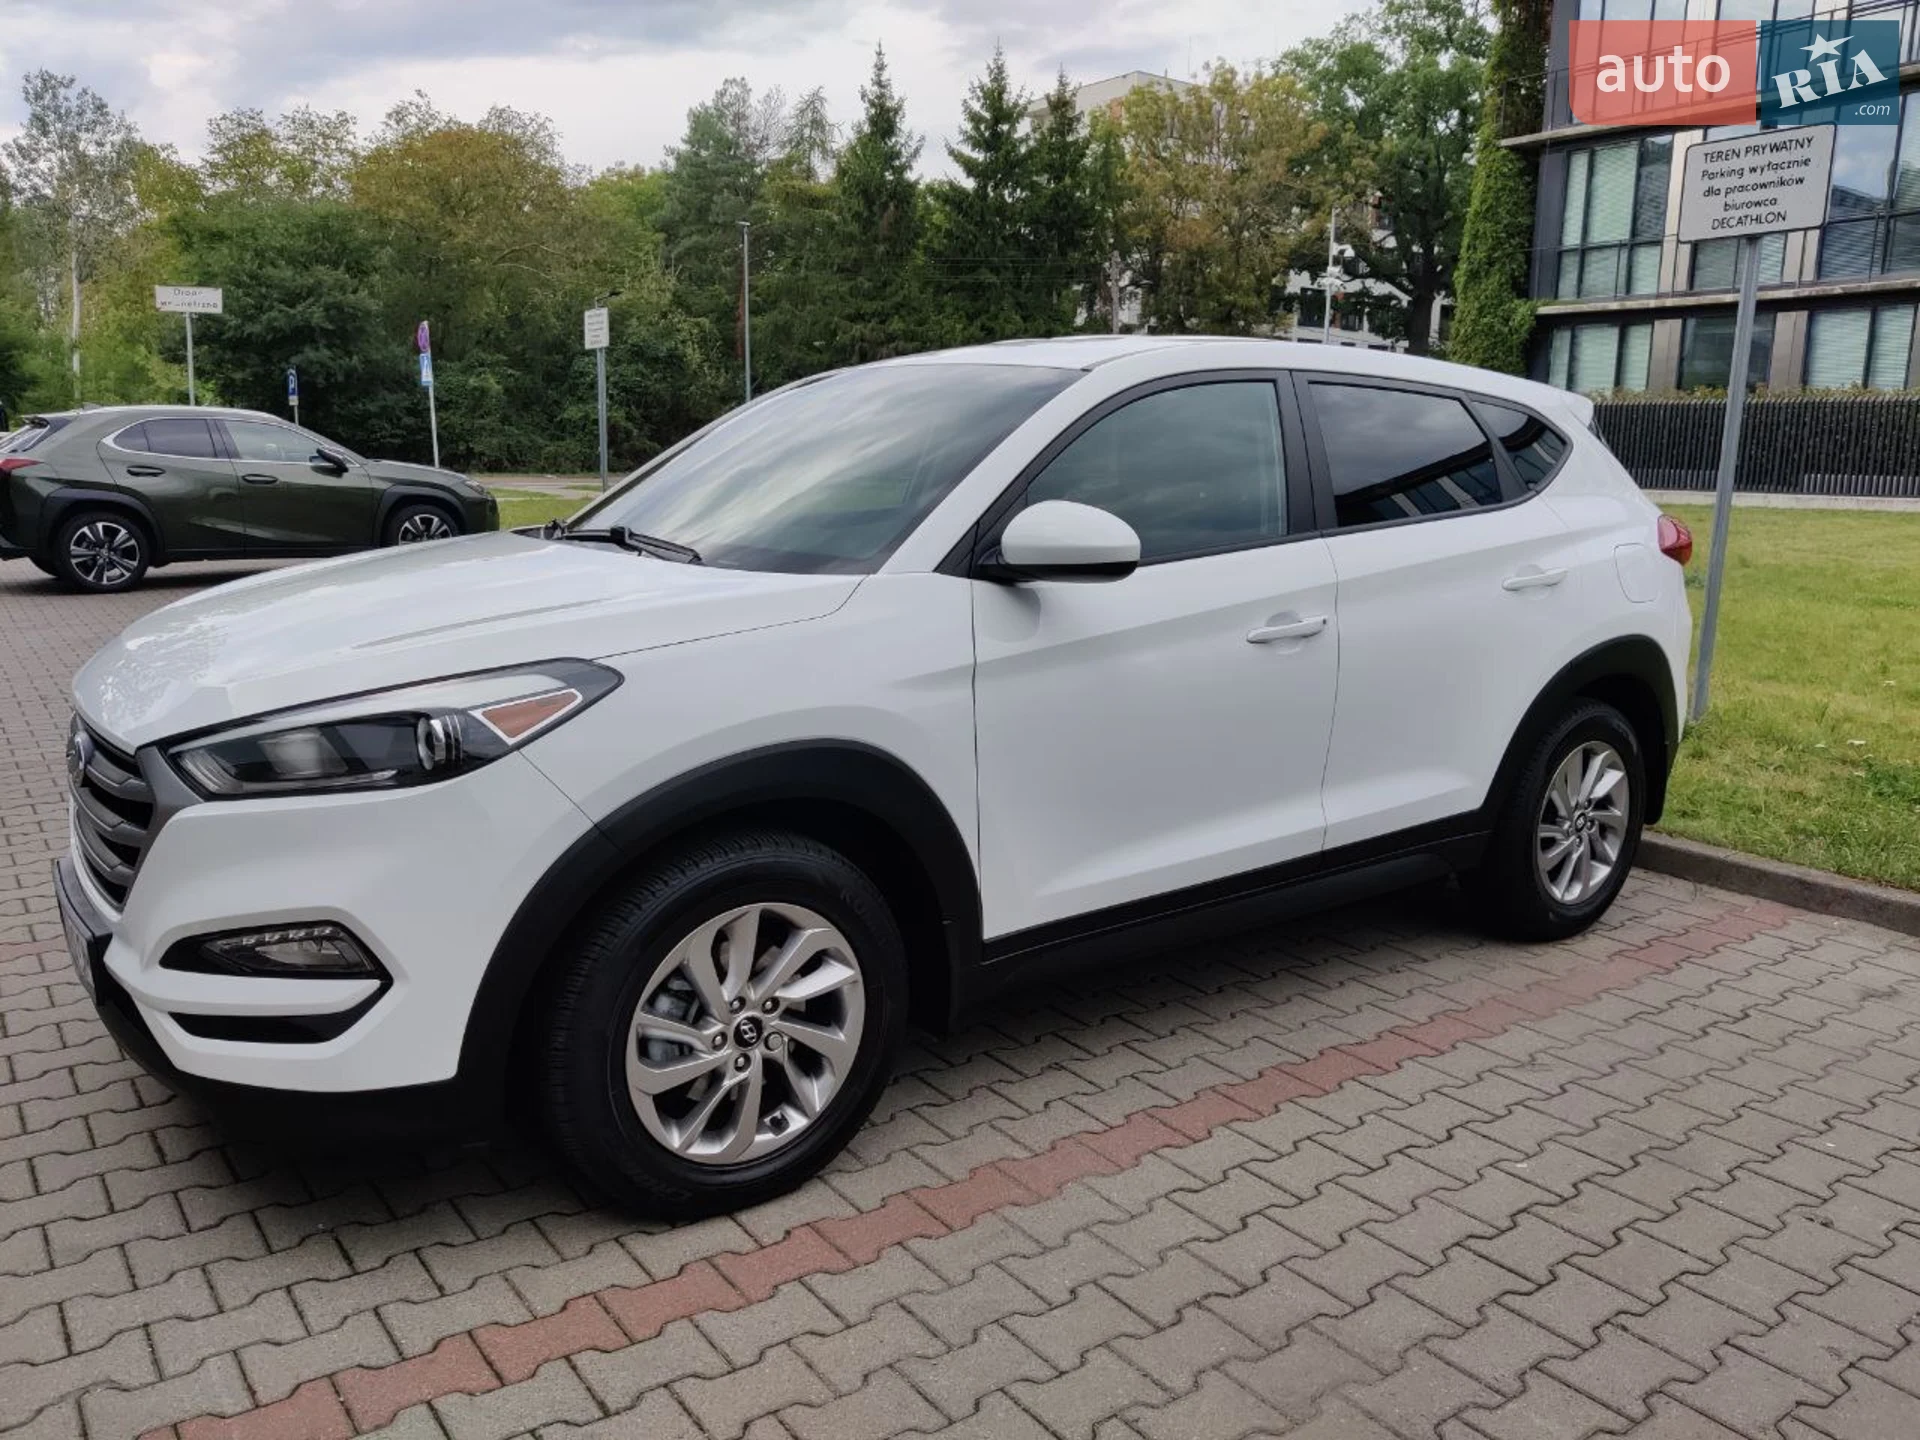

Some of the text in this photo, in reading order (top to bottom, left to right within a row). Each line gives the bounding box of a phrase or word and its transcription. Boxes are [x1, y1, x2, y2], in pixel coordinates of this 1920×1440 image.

[1703, 136, 1814, 164] TEREN PRYWATNY
[1701, 155, 1812, 180] Parking wyłącznie
[1703, 174, 1805, 198] dla pracowników
[1723, 197, 1778, 212] biurowca
[1711, 210, 1787, 231] DECATHLON
